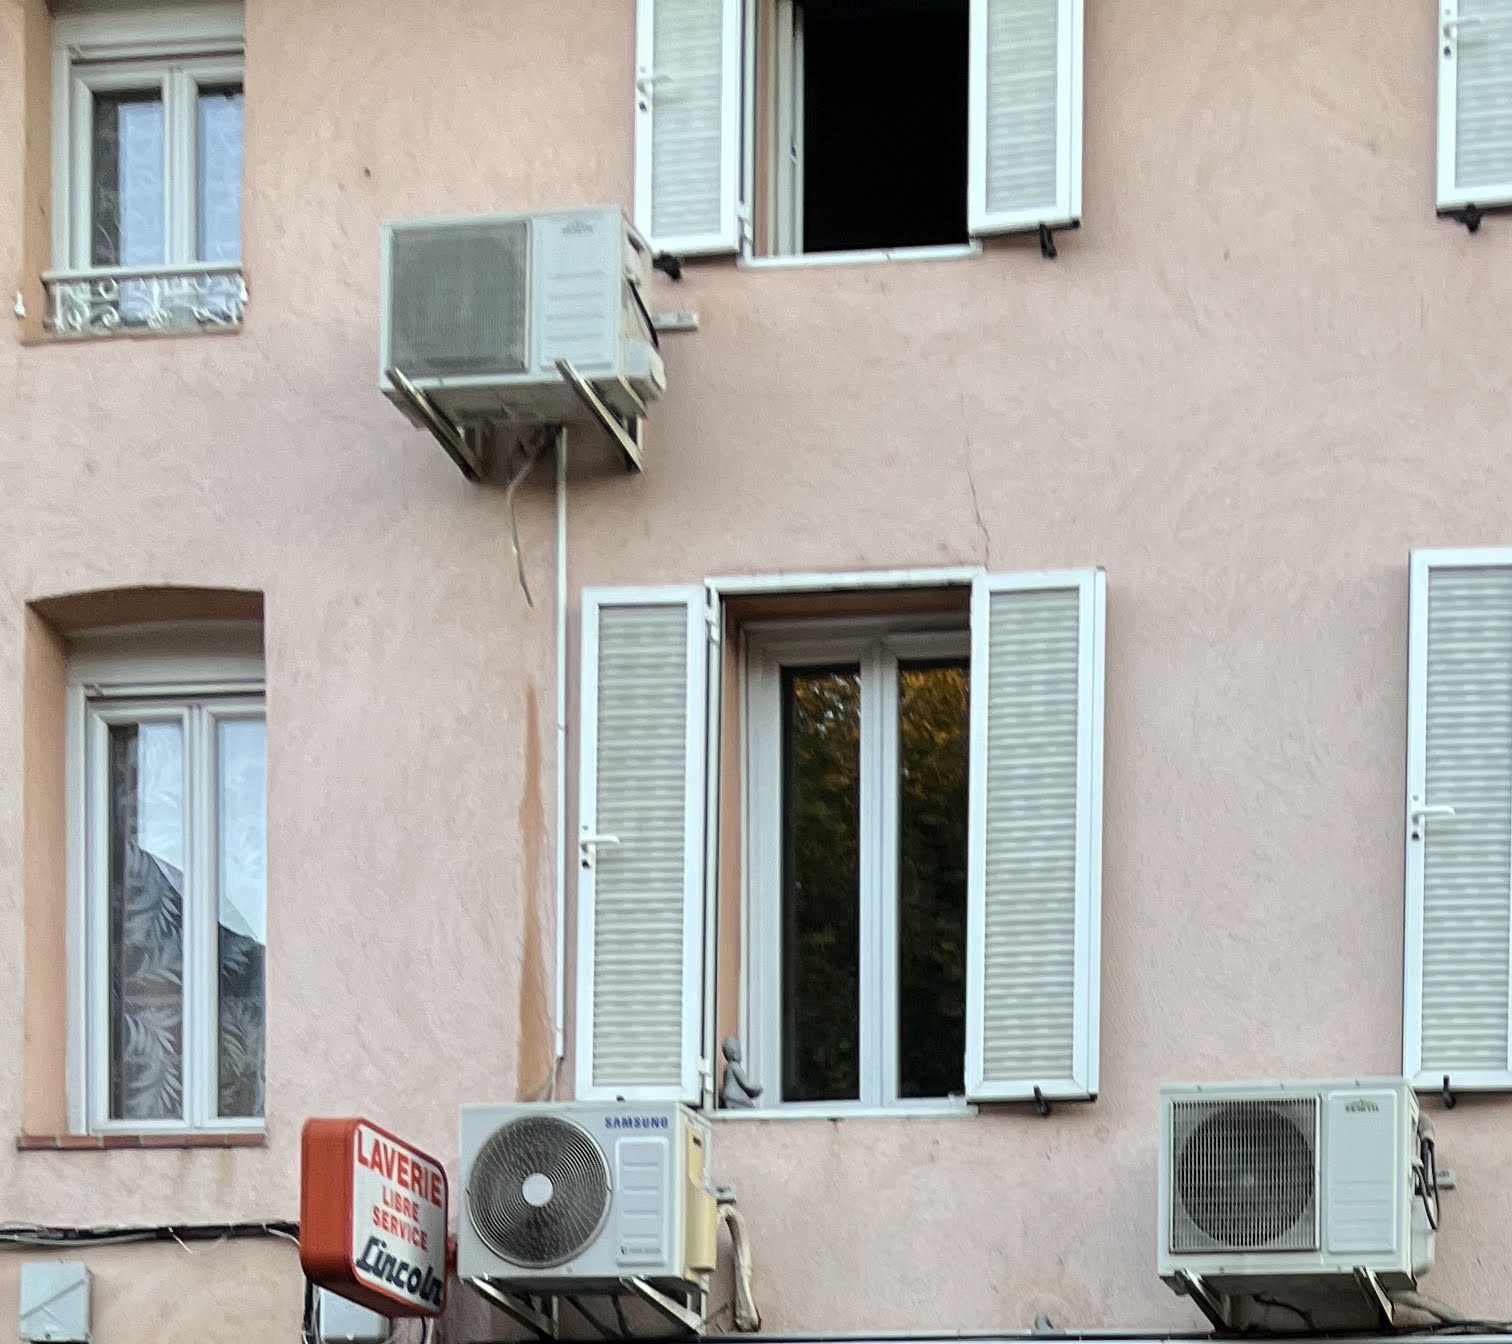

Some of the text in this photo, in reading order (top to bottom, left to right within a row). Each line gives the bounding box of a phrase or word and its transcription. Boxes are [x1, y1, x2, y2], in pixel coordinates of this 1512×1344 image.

[604, 1115, 669, 1129] SAMSUNG
[357, 1127, 443, 1209] LAVERIE
[382, 1185, 419, 1222] LIBRE
[372, 1204, 428, 1252] SERVICE
[355, 1234, 443, 1306] Lincoln
